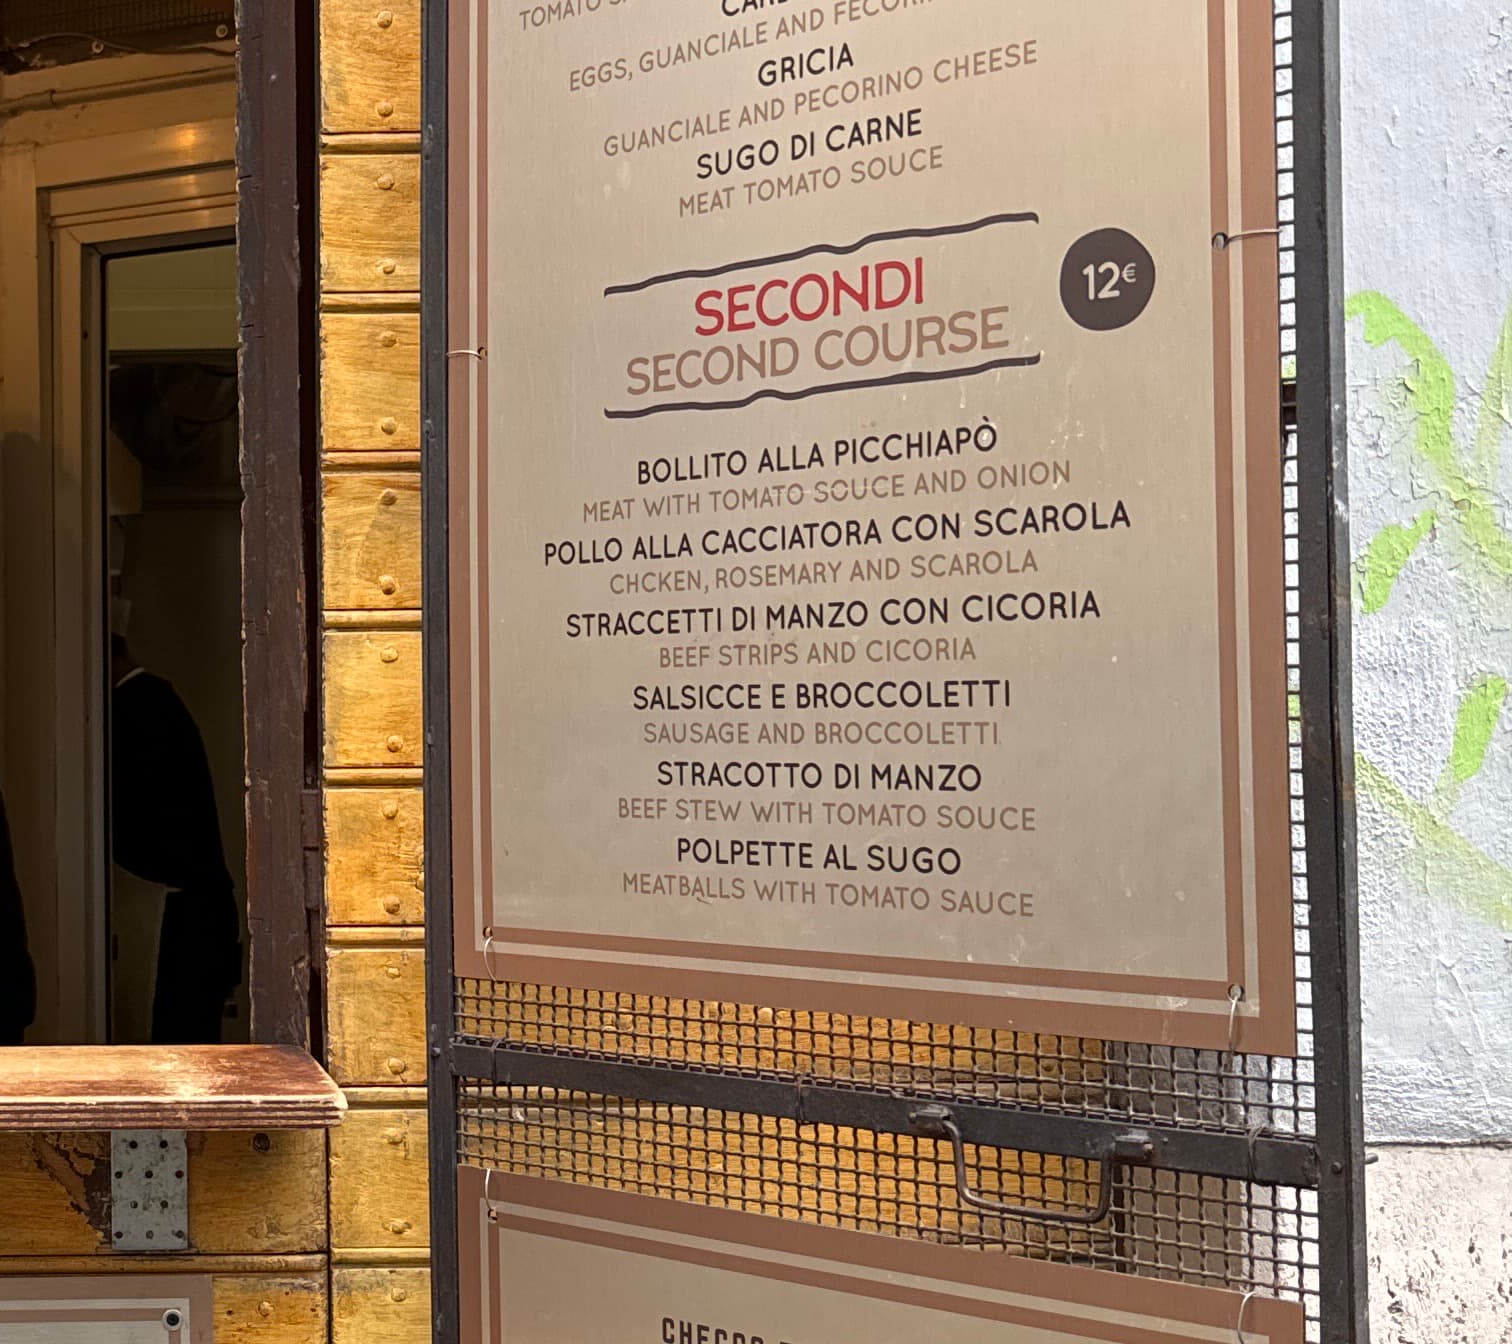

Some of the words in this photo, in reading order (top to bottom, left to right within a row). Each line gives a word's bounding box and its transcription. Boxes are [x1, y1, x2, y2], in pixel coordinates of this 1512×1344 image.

[758, 43, 854, 86] GRICIA
[697, 139, 779, 179] SUGO
[791, 132, 815, 160] DI
[826, 108, 922, 152] CARNE
[679, 186, 735, 217] MEAT
[743, 166, 841, 204] TOMATO
[851, 145, 943, 184] SOUCE
[695, 257, 923, 336] SECONDI
[627, 337, 799, 395] SECOND
[814, 306, 1009, 370] COURSE
[638, 450, 747, 485] BOLLITO
[758, 443, 824, 473] ALLA
[835, 416, 997, 465] PICCHIAPÒ
[545, 537, 623, 565] POLLO
[632, 533, 693, 560] ALLA
[702, 519, 882, 555] CACCIATORA
[892, 513, 960, 542] CON
[975, 500, 1131, 537] SCAROLA
[716, 561, 842, 588] ROSEMARY
[850, 557, 900, 581] AND
[911, 549, 1038, 578] SCAROLA
[634, 684, 761, 710] SALSICCE
[772, 684, 785, 709] E
[796, 680, 1010, 709] BROCCOLETTI
[658, 761, 822, 789] STRACOTTO
[835, 763, 859, 789] DI
[871, 764, 981, 792] MANZO
[678, 838, 813, 868] POLPETTE
[823, 844, 857, 871] AL
[867, 845, 961, 875] SUGO
[623, 873, 745, 900] MEATBALLS
[753, 880, 815, 904] WITH
[825, 883, 930, 910] TOMATO
[941, 889, 1034, 917] SAUCE
